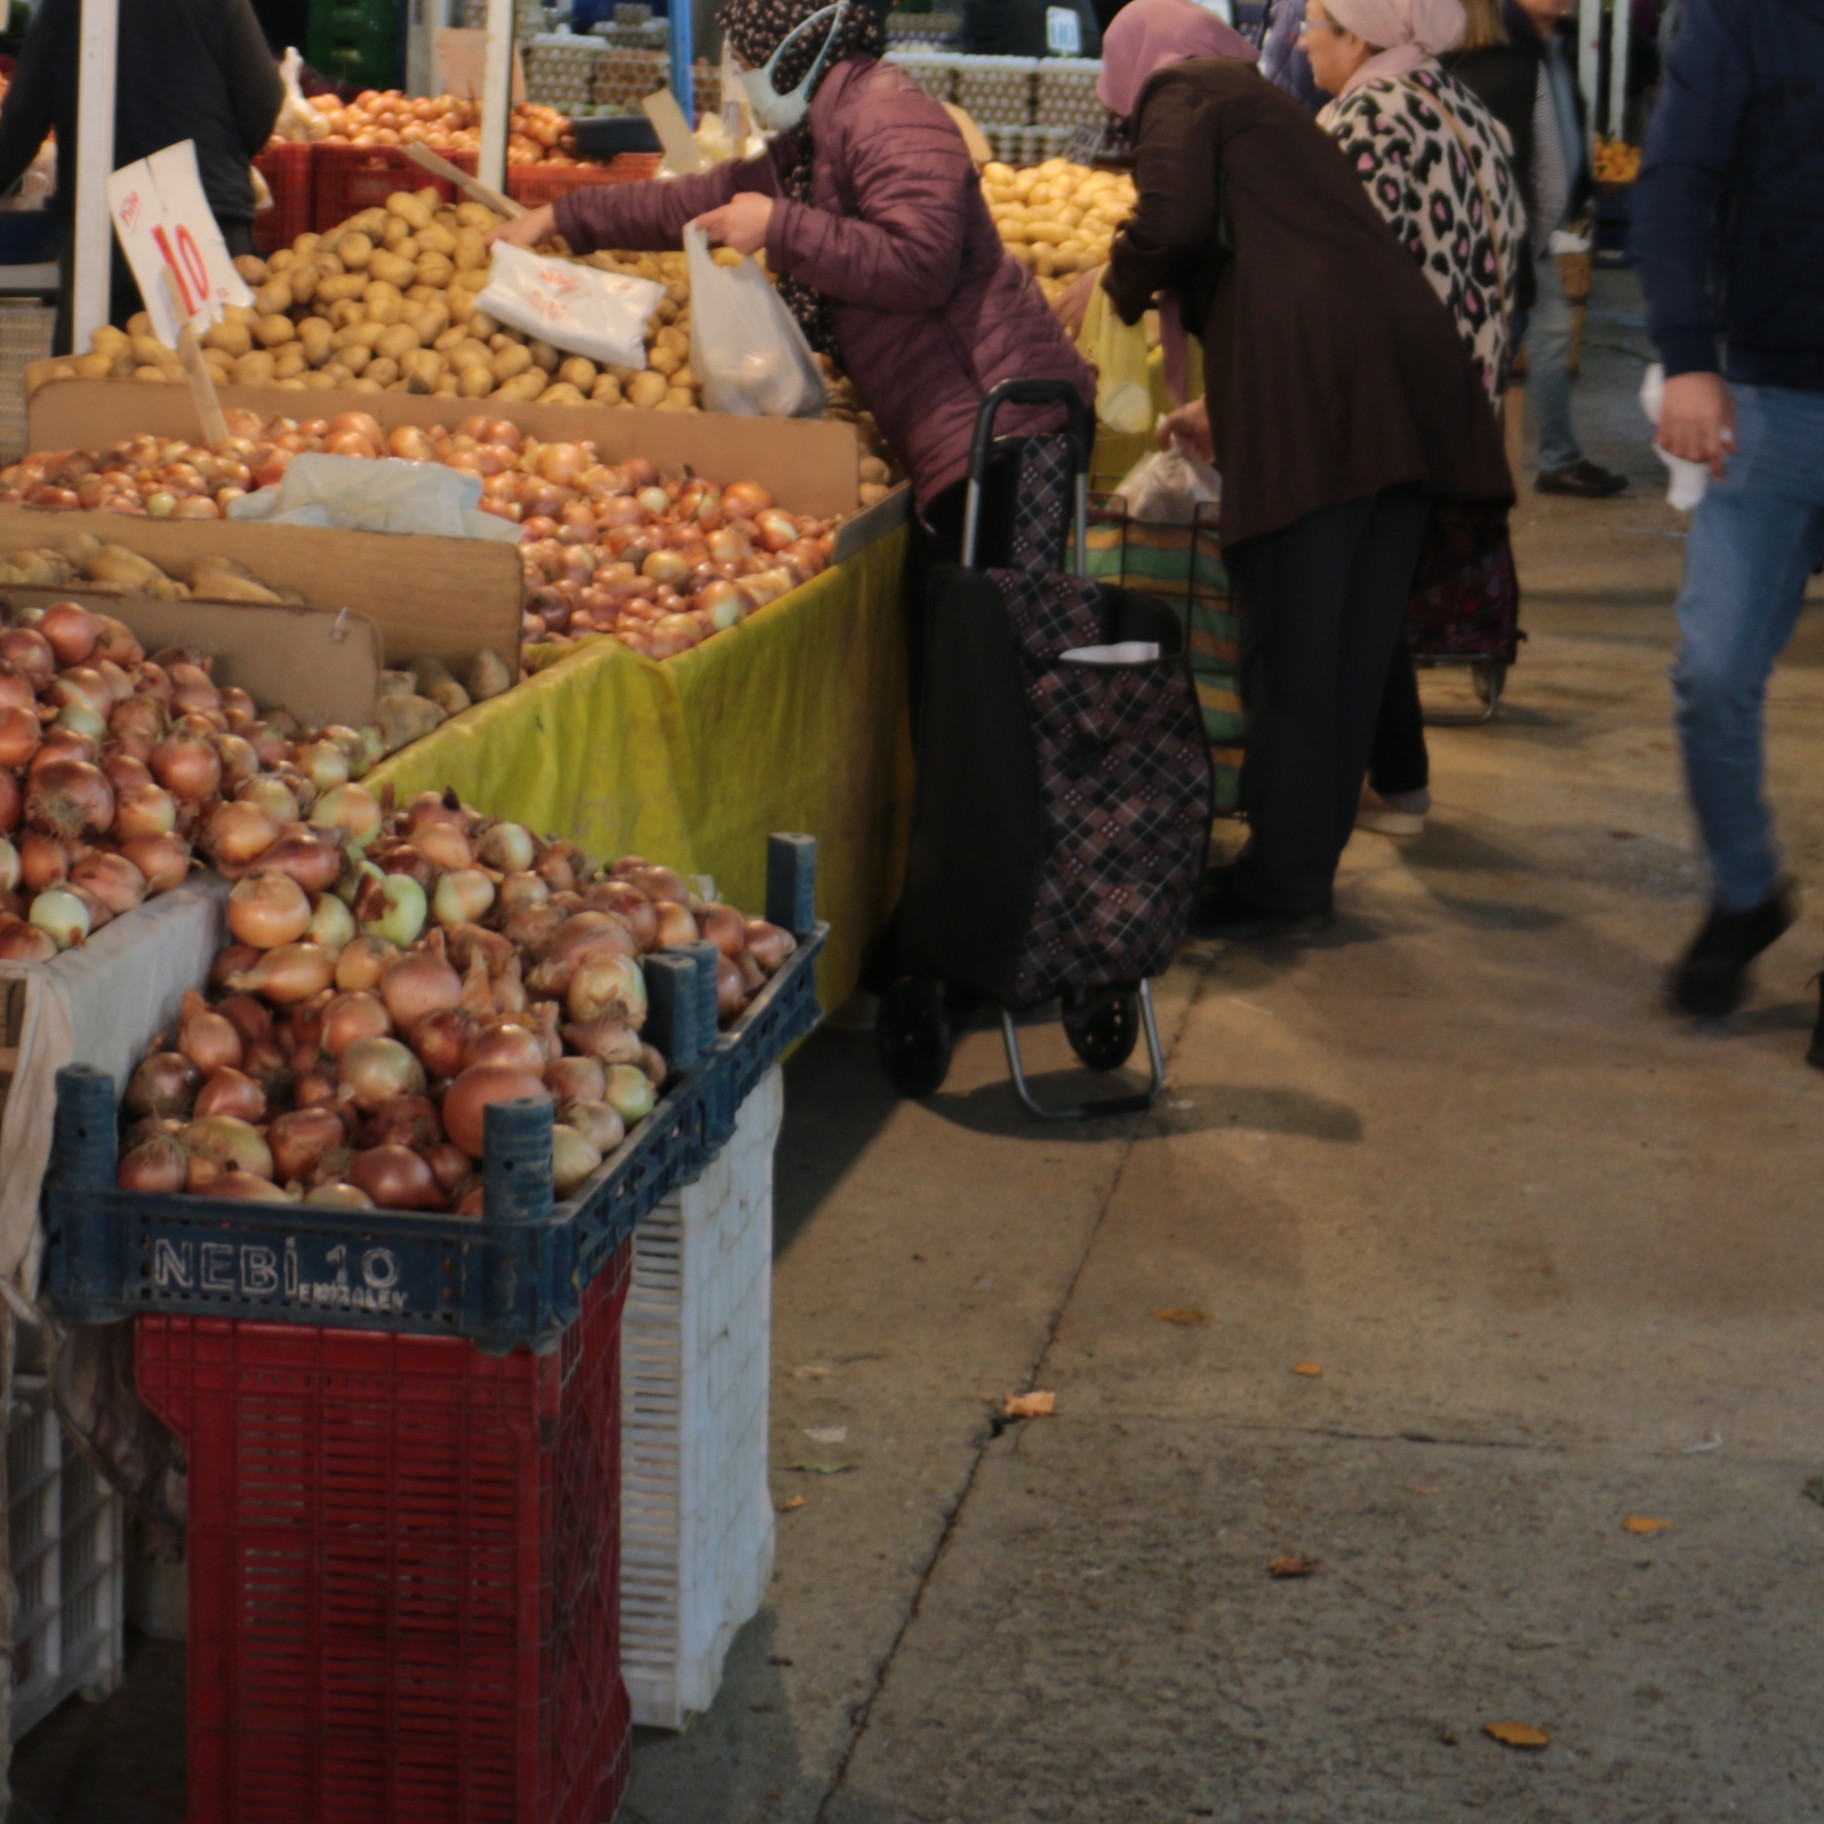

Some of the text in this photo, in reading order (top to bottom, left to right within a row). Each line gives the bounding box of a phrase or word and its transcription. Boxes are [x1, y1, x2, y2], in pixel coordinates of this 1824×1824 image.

[150, 222, 210, 317] 10
[154, 1235, 402, 1297] NEBİ 10
